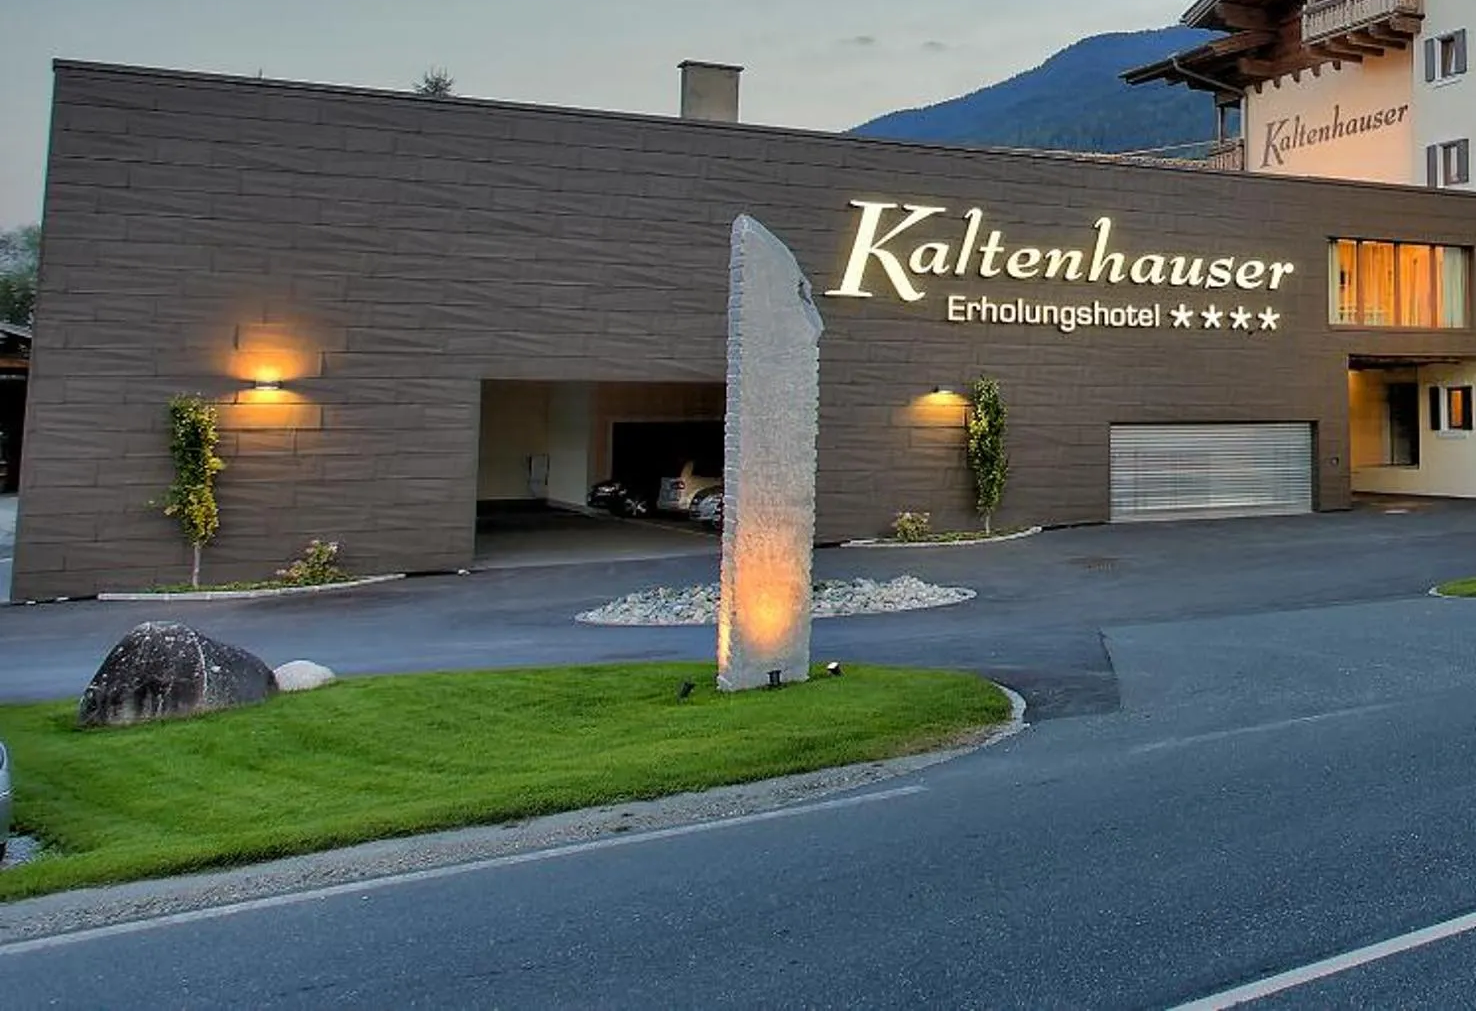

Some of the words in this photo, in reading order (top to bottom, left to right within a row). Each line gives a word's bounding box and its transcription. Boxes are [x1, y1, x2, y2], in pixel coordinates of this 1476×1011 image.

[1260, 104, 1409, 168] Kaltenhauser
[824, 199, 1295, 302] Kaltenhauser
[947, 296, 1161, 332] Erholungshotel
